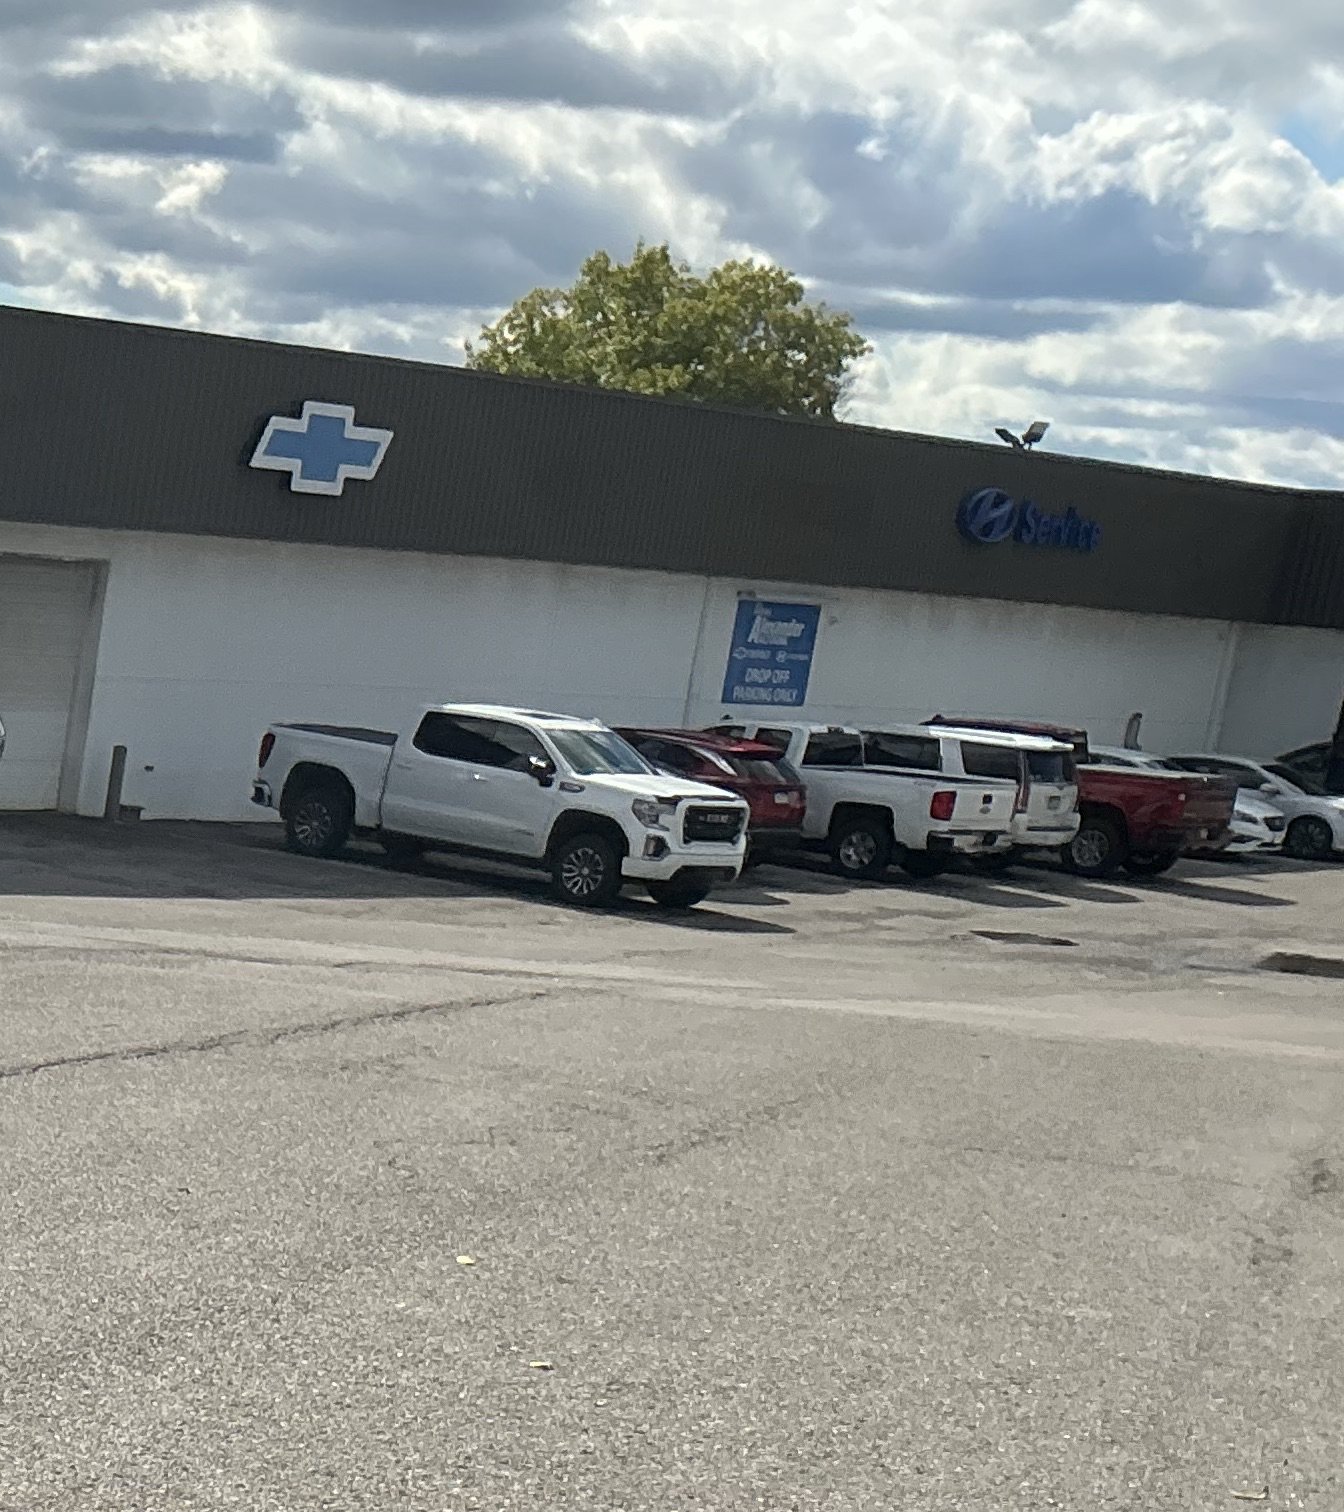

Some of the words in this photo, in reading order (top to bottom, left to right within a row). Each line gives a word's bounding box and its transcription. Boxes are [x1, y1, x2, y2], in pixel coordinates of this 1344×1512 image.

[745, 667, 772, 683] DROP
[772, 669, 791, 684] OFF
[733, 685, 773, 702] PARKING
[774, 687, 798, 703] ONLY
